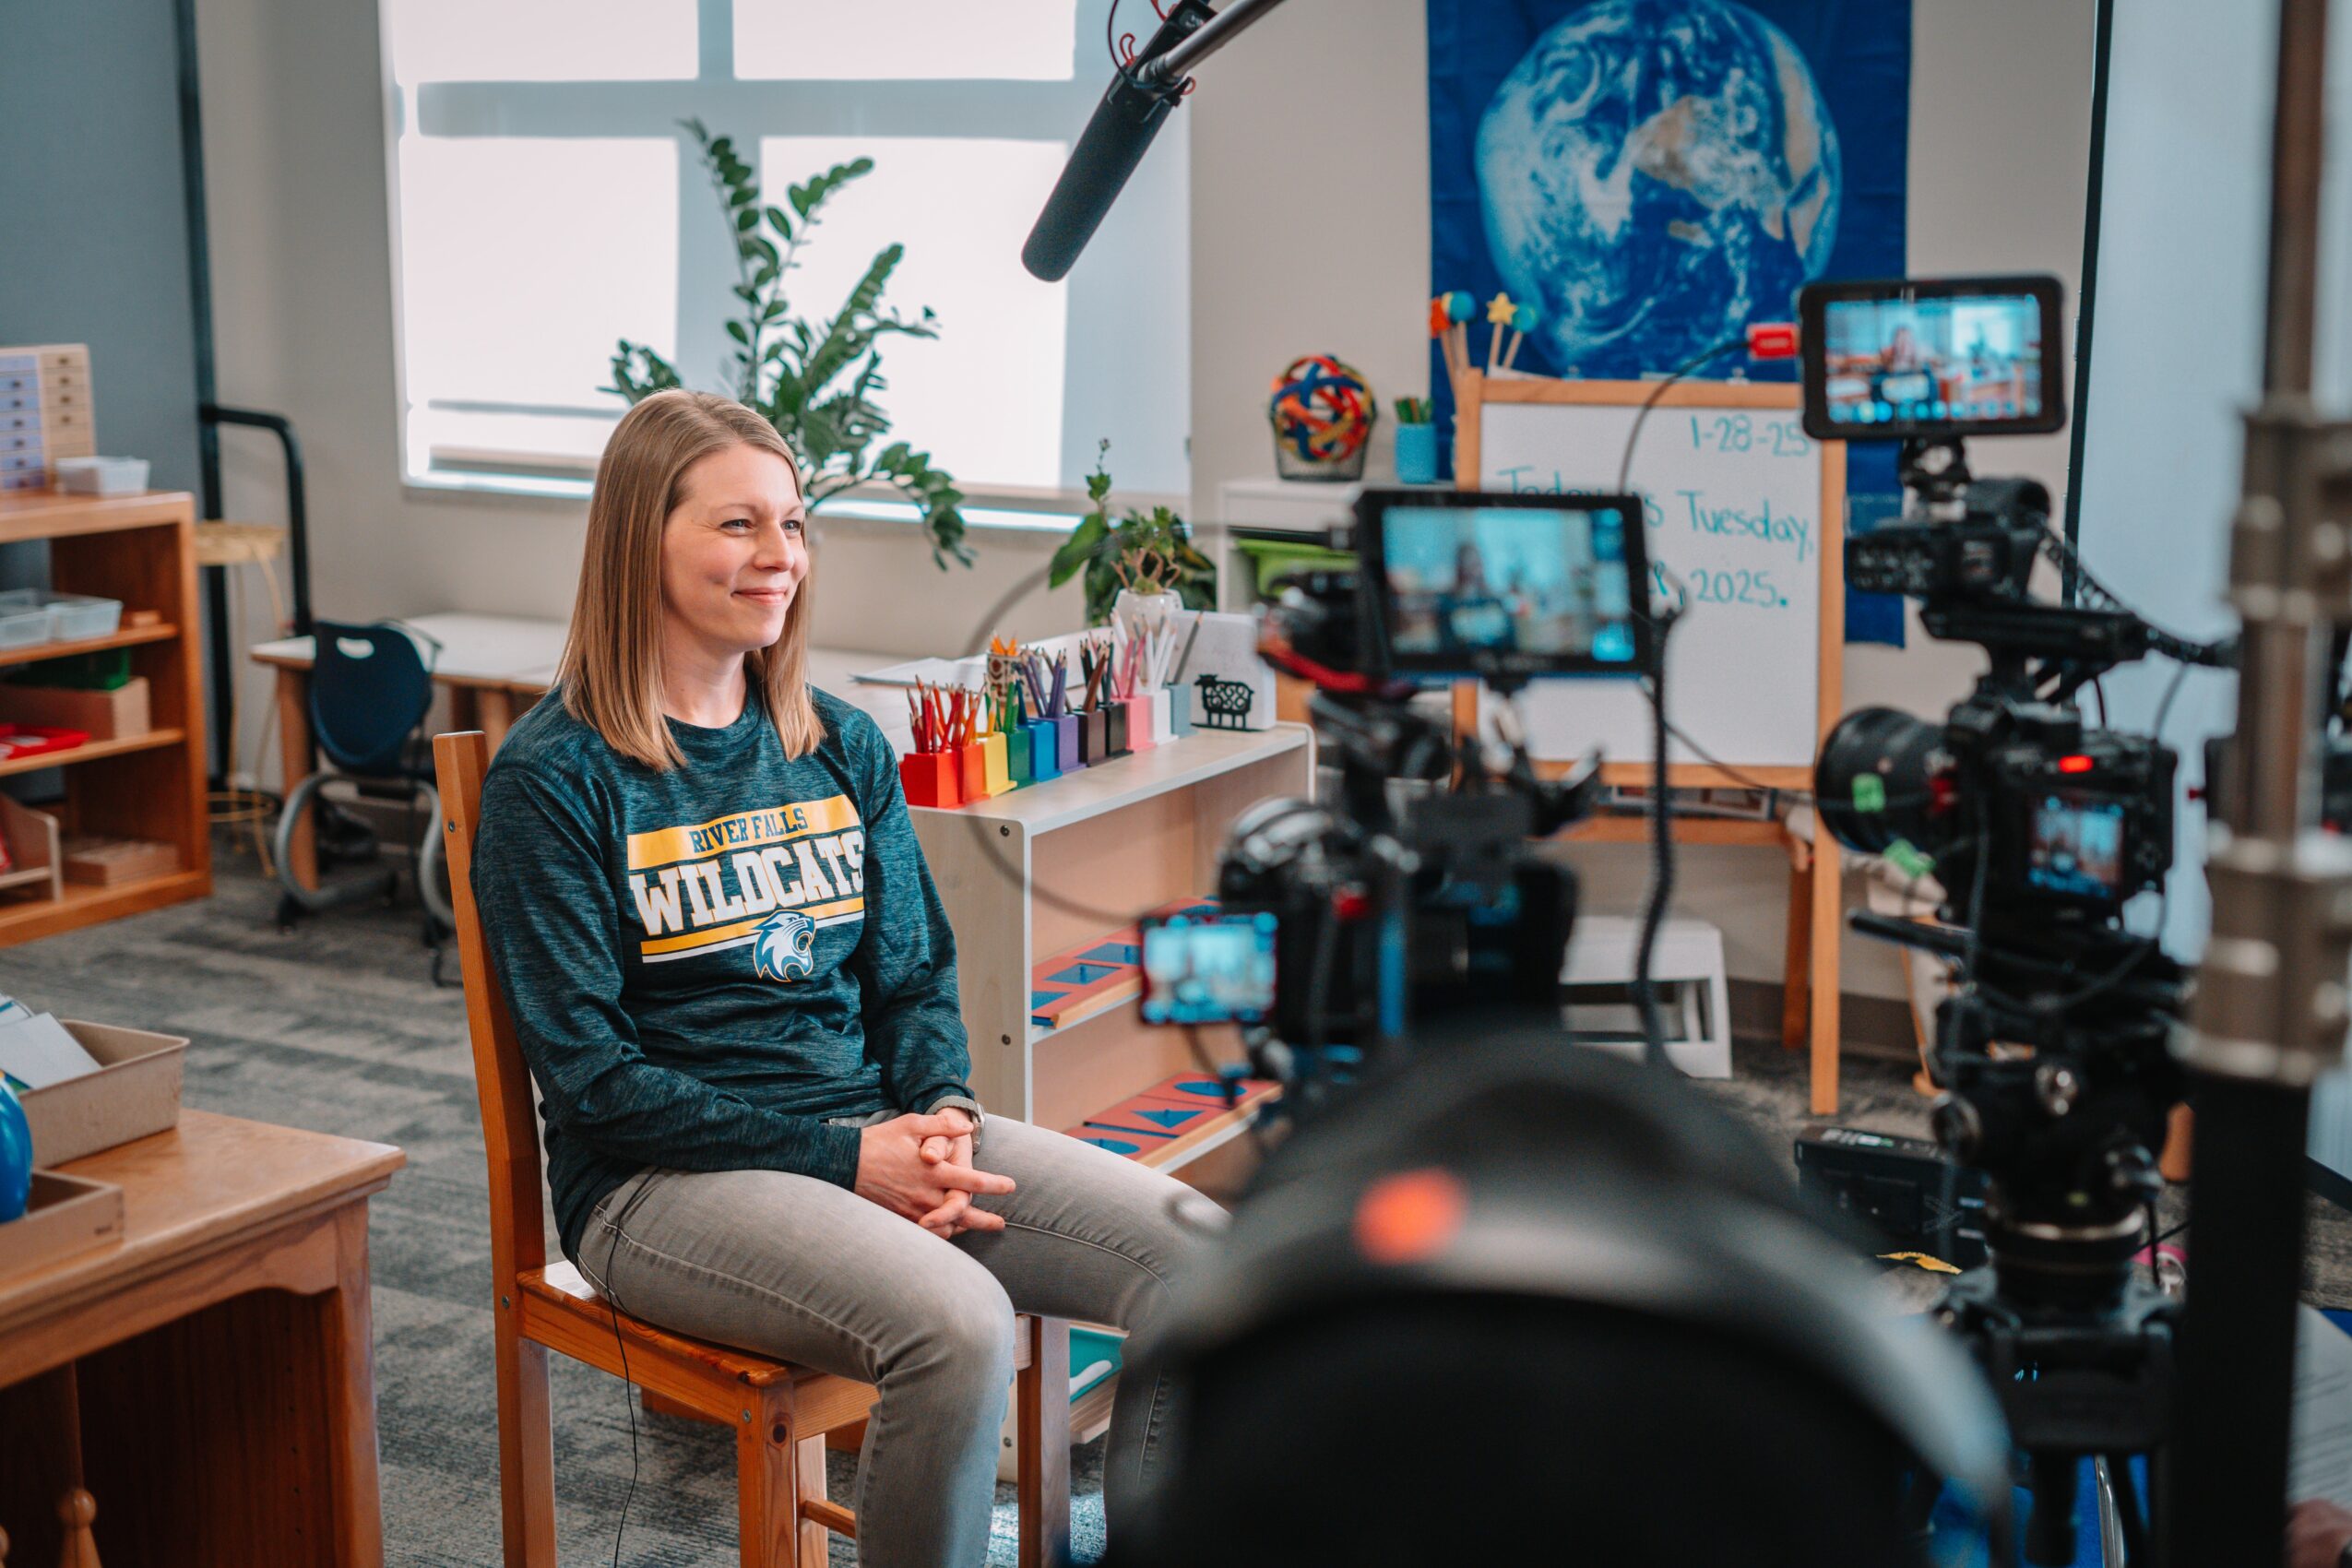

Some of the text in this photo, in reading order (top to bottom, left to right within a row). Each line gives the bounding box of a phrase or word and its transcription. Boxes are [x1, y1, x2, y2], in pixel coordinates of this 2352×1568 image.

[1690, 414, 1812, 457] 1-28-25
[1690, 568, 1789, 609] 2025.
[688, 806, 809, 854] RIVER FALLS
[628, 829, 865, 937] WILDCATS
